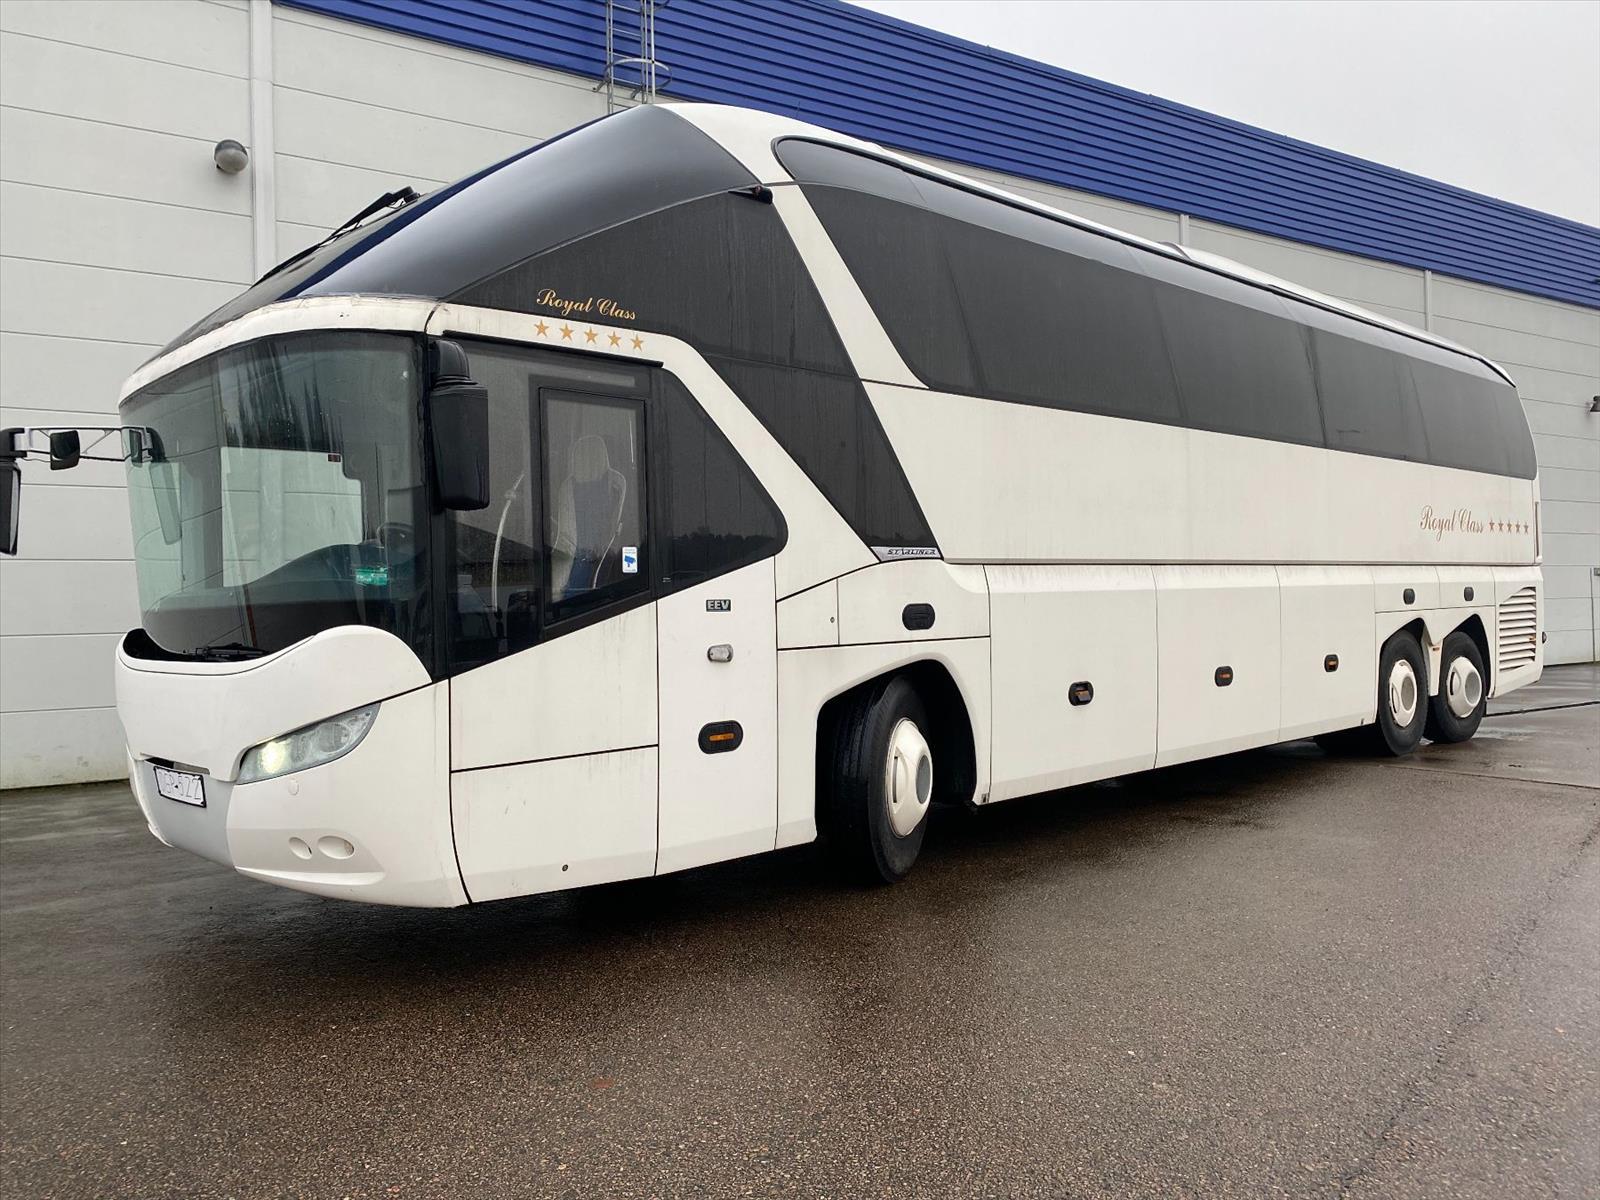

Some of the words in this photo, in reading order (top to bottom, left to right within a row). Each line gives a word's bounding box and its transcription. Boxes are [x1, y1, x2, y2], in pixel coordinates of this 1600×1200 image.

[536, 288, 593, 316] Royal
[596, 298, 636, 320] Class
[1419, 504, 1456, 542] Royal
[1457, 508, 1484, 533] Class
[887, 548, 936, 556] STARLINER
[707, 600, 730, 610] EEV
